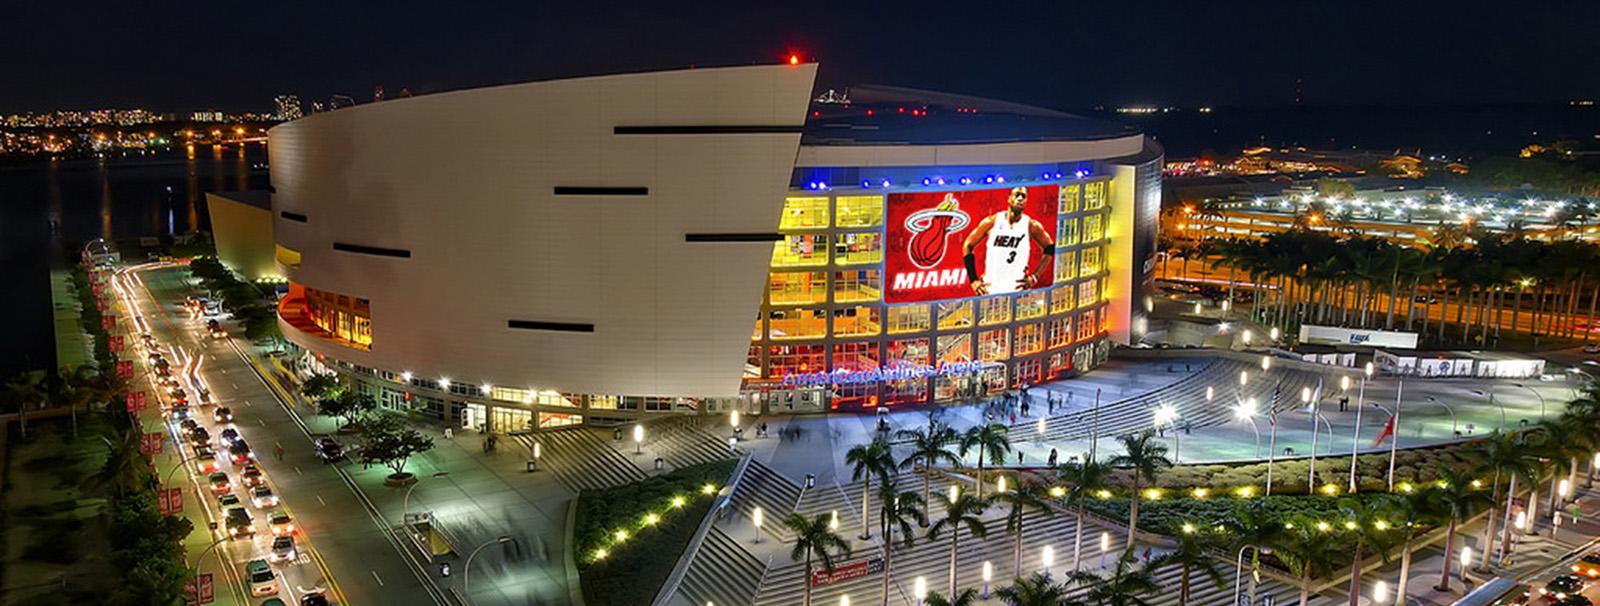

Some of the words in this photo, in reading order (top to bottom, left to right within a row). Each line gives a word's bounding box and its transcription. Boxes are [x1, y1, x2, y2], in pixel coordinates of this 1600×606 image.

[993, 234, 1025, 249] HEAT
[1006, 251, 1016, 264] 3
[893, 268, 968, 290] MIAMI
